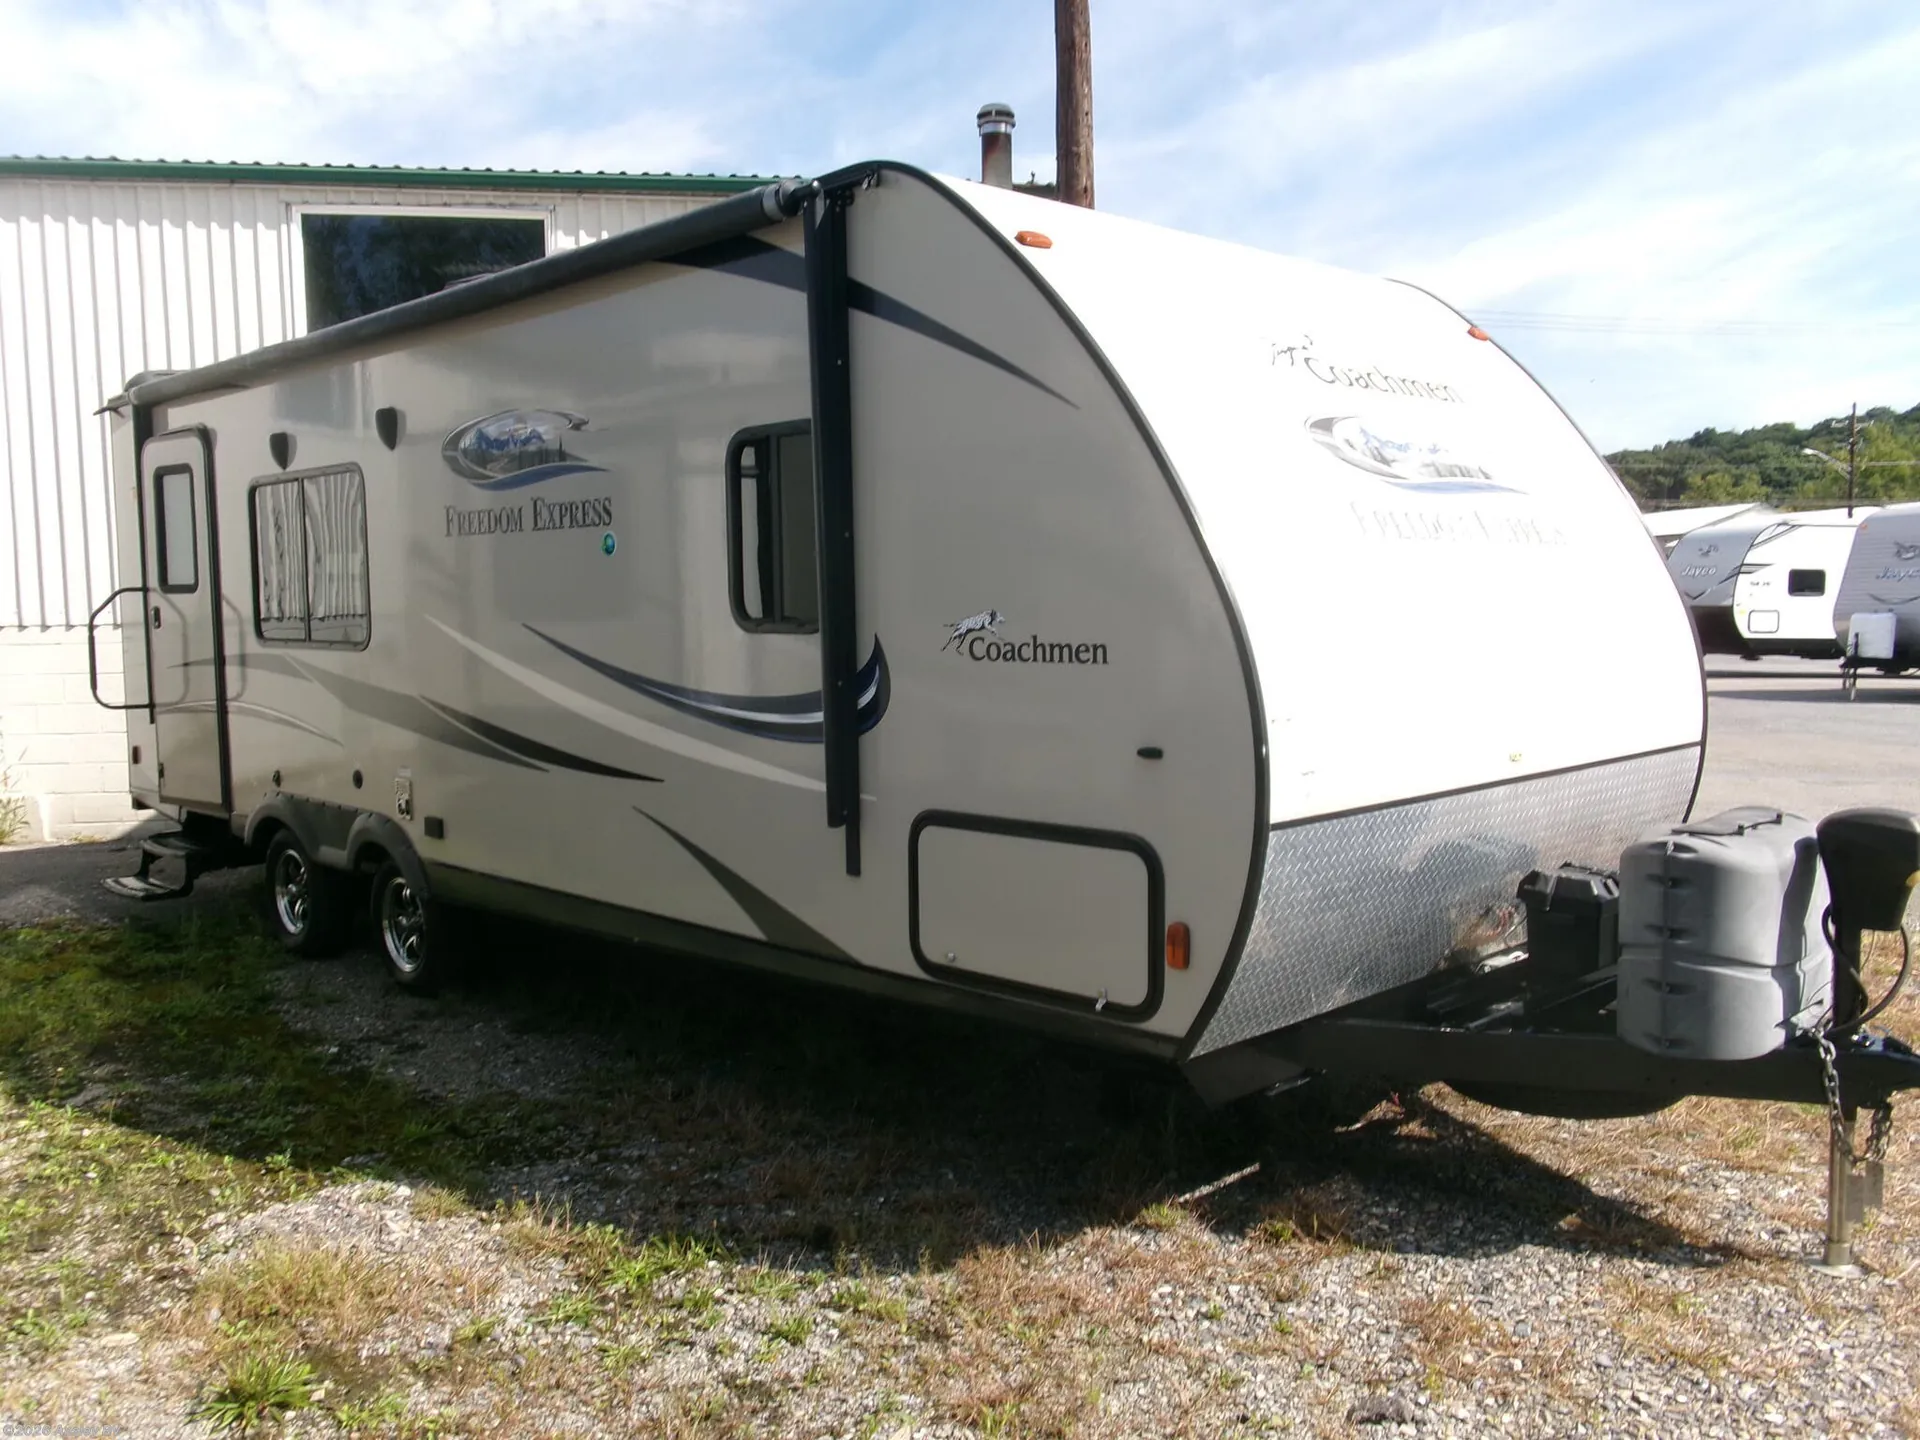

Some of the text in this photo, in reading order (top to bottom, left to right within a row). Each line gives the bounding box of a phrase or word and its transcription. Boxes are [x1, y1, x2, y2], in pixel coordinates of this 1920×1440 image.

[443, 496, 613, 538] FREEDOM EXPRESS
[1681, 564, 1717, 579] Jayco
[968, 634, 1109, 665] Coachmen
